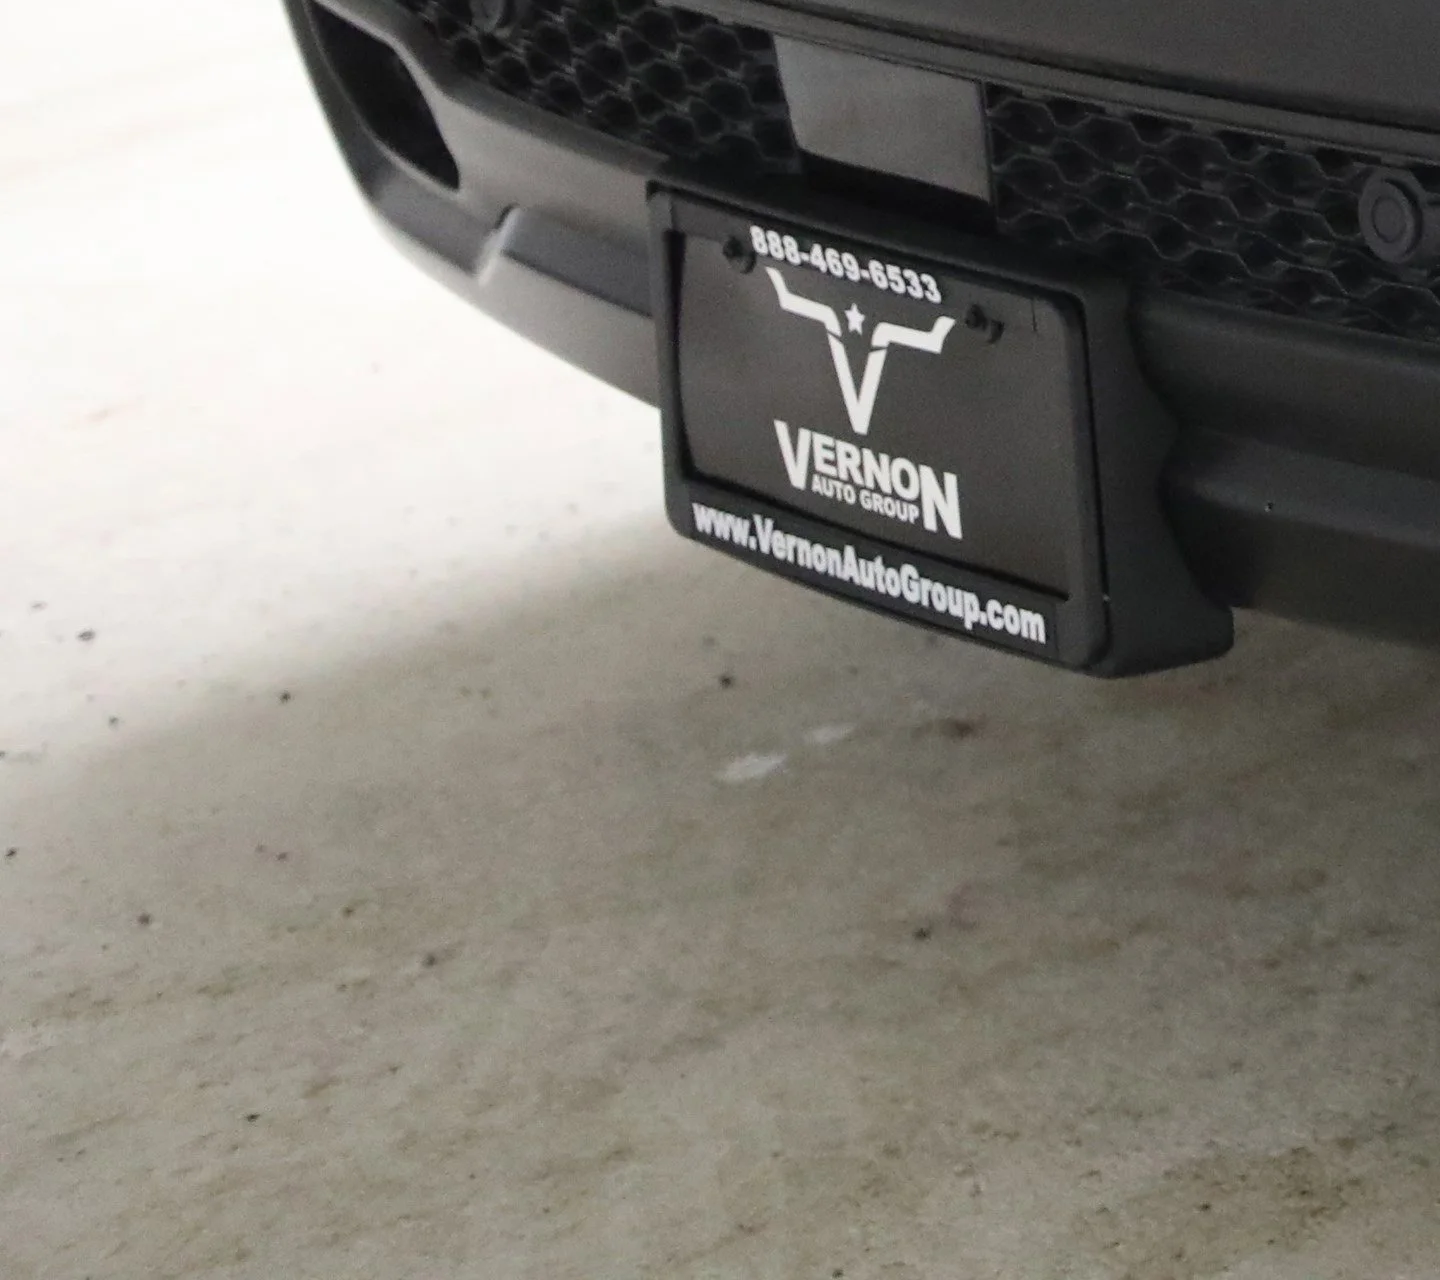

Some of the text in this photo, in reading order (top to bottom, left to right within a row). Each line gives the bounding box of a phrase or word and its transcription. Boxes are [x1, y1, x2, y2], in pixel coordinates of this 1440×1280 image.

[751, 225, 942, 304] 888-469-6533
[773, 419, 963, 539] VERNON
[811, 475, 919, 523] AUTO GROUP
[692, 502, 1046, 644] www.VernonAutoGroup.com
